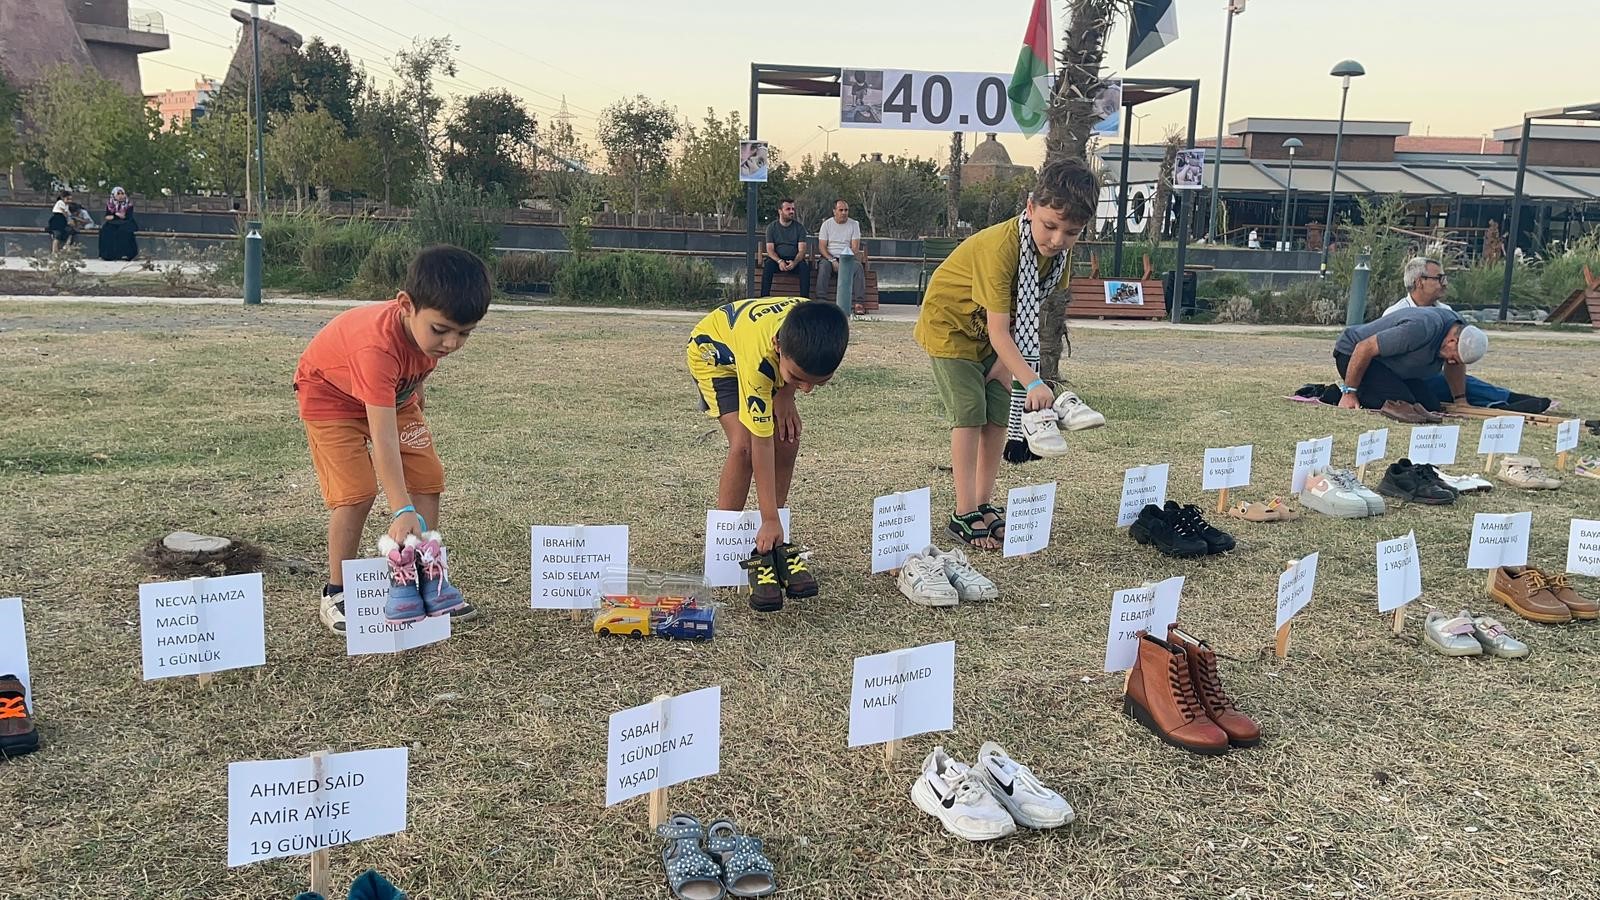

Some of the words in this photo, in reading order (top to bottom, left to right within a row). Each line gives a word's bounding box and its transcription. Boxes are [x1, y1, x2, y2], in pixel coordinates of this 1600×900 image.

[1012, 493, 1048, 505] MUHAMMED
[1011, 509, 1030, 518] KERİM
[716, 522, 736, 531] FEDİ
[878, 517, 903, 528] AHMED
[903, 514, 916, 524] EBU
[1480, 522, 1513, 531] MAHMUT
[542, 536, 586, 548] İBRAHİM
[715, 536, 742, 546] MUSA
[744, 537, 757, 546] HA
[1009, 533, 1034, 544] GÜNLÜK
[877, 548, 882, 557] 2
[882, 543, 910, 555] GÜNLÜK
[1383, 543, 1403, 555] JOUD
[542, 553, 611, 563] ABDULFETTAH
[715, 553, 721, 561] 1
[1384, 562, 1389, 571] 1
[542, 569, 565, 581] SAİD
[567, 570, 600, 581] SELAM
[356, 587, 390, 599] İBRAH
[542, 588, 549, 597] 2
[551, 586, 592, 597] GÜNLÜK
[155, 595, 198, 608] NECVA
[200, 589, 246, 604] HAMZA
[357, 606, 380, 617] EBU
[156, 613, 199, 629] MACİD
[359, 625, 365, 634] 1
[157, 632, 215, 647] HAMDAN
[1118, 631, 1124, 641] 7
[158, 657, 166, 667] 1
[169, 649, 221, 666] GÜNLÜK
[864, 667, 932, 689] MUHAMMED
[863, 692, 898, 709] MALİK
[620, 721, 660, 742] SABAH
[620, 737, 677, 766] 1GÜNDEN
[679, 733, 694, 748] AZ
[250, 779, 320, 798] AHMED
[324, 771, 364, 791] SAİD
[619, 767, 659, 790] YAŞADI
[249, 806, 299, 826] AMİR
[304, 801, 351, 820] AYİŞE
[251, 840, 272, 855] 19
[277, 829, 352, 853] GÜNLÜK
